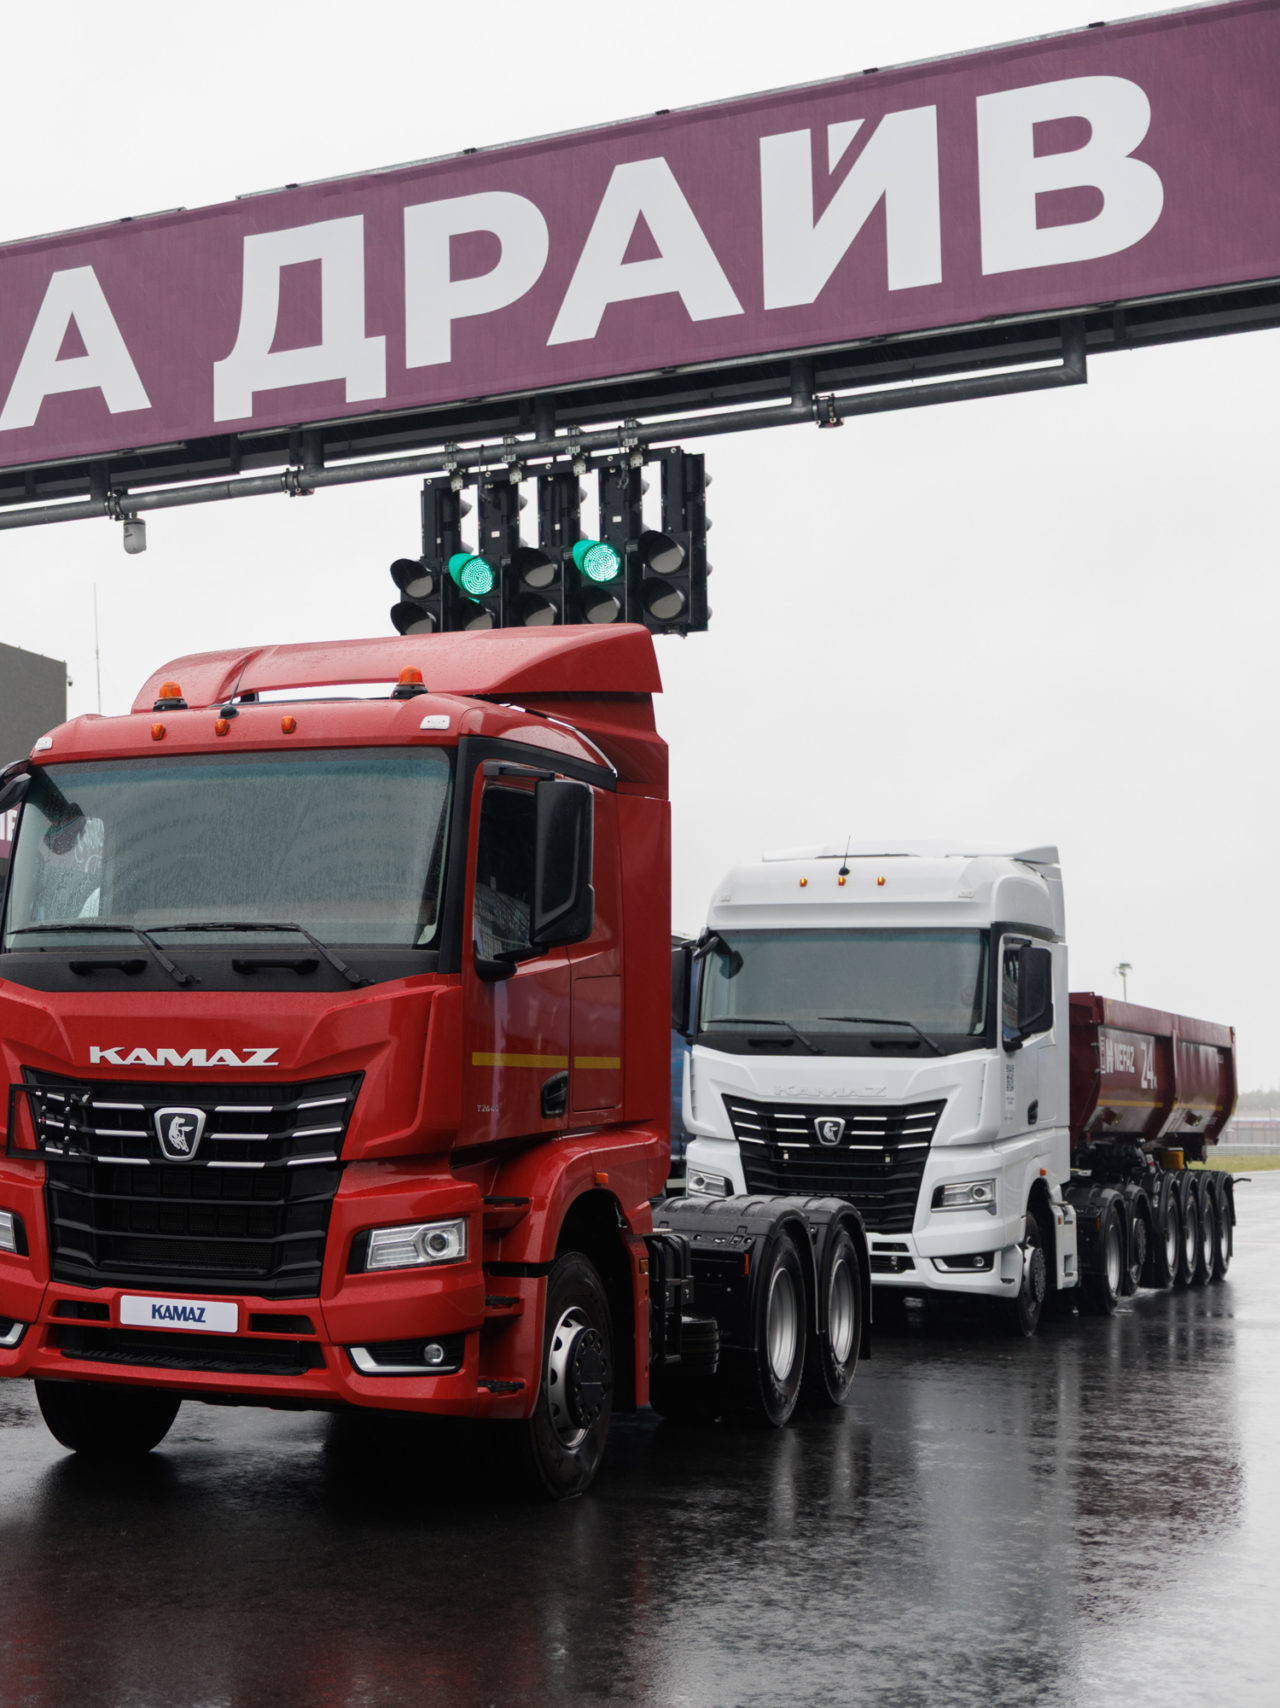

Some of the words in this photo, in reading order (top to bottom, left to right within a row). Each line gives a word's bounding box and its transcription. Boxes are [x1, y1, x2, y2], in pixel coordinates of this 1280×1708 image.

[213, 75, 1165, 423] ДРАЙВ
[89, 1046, 280, 1067] KAMAZ
[151, 1304, 206, 1323] KAMAZ
